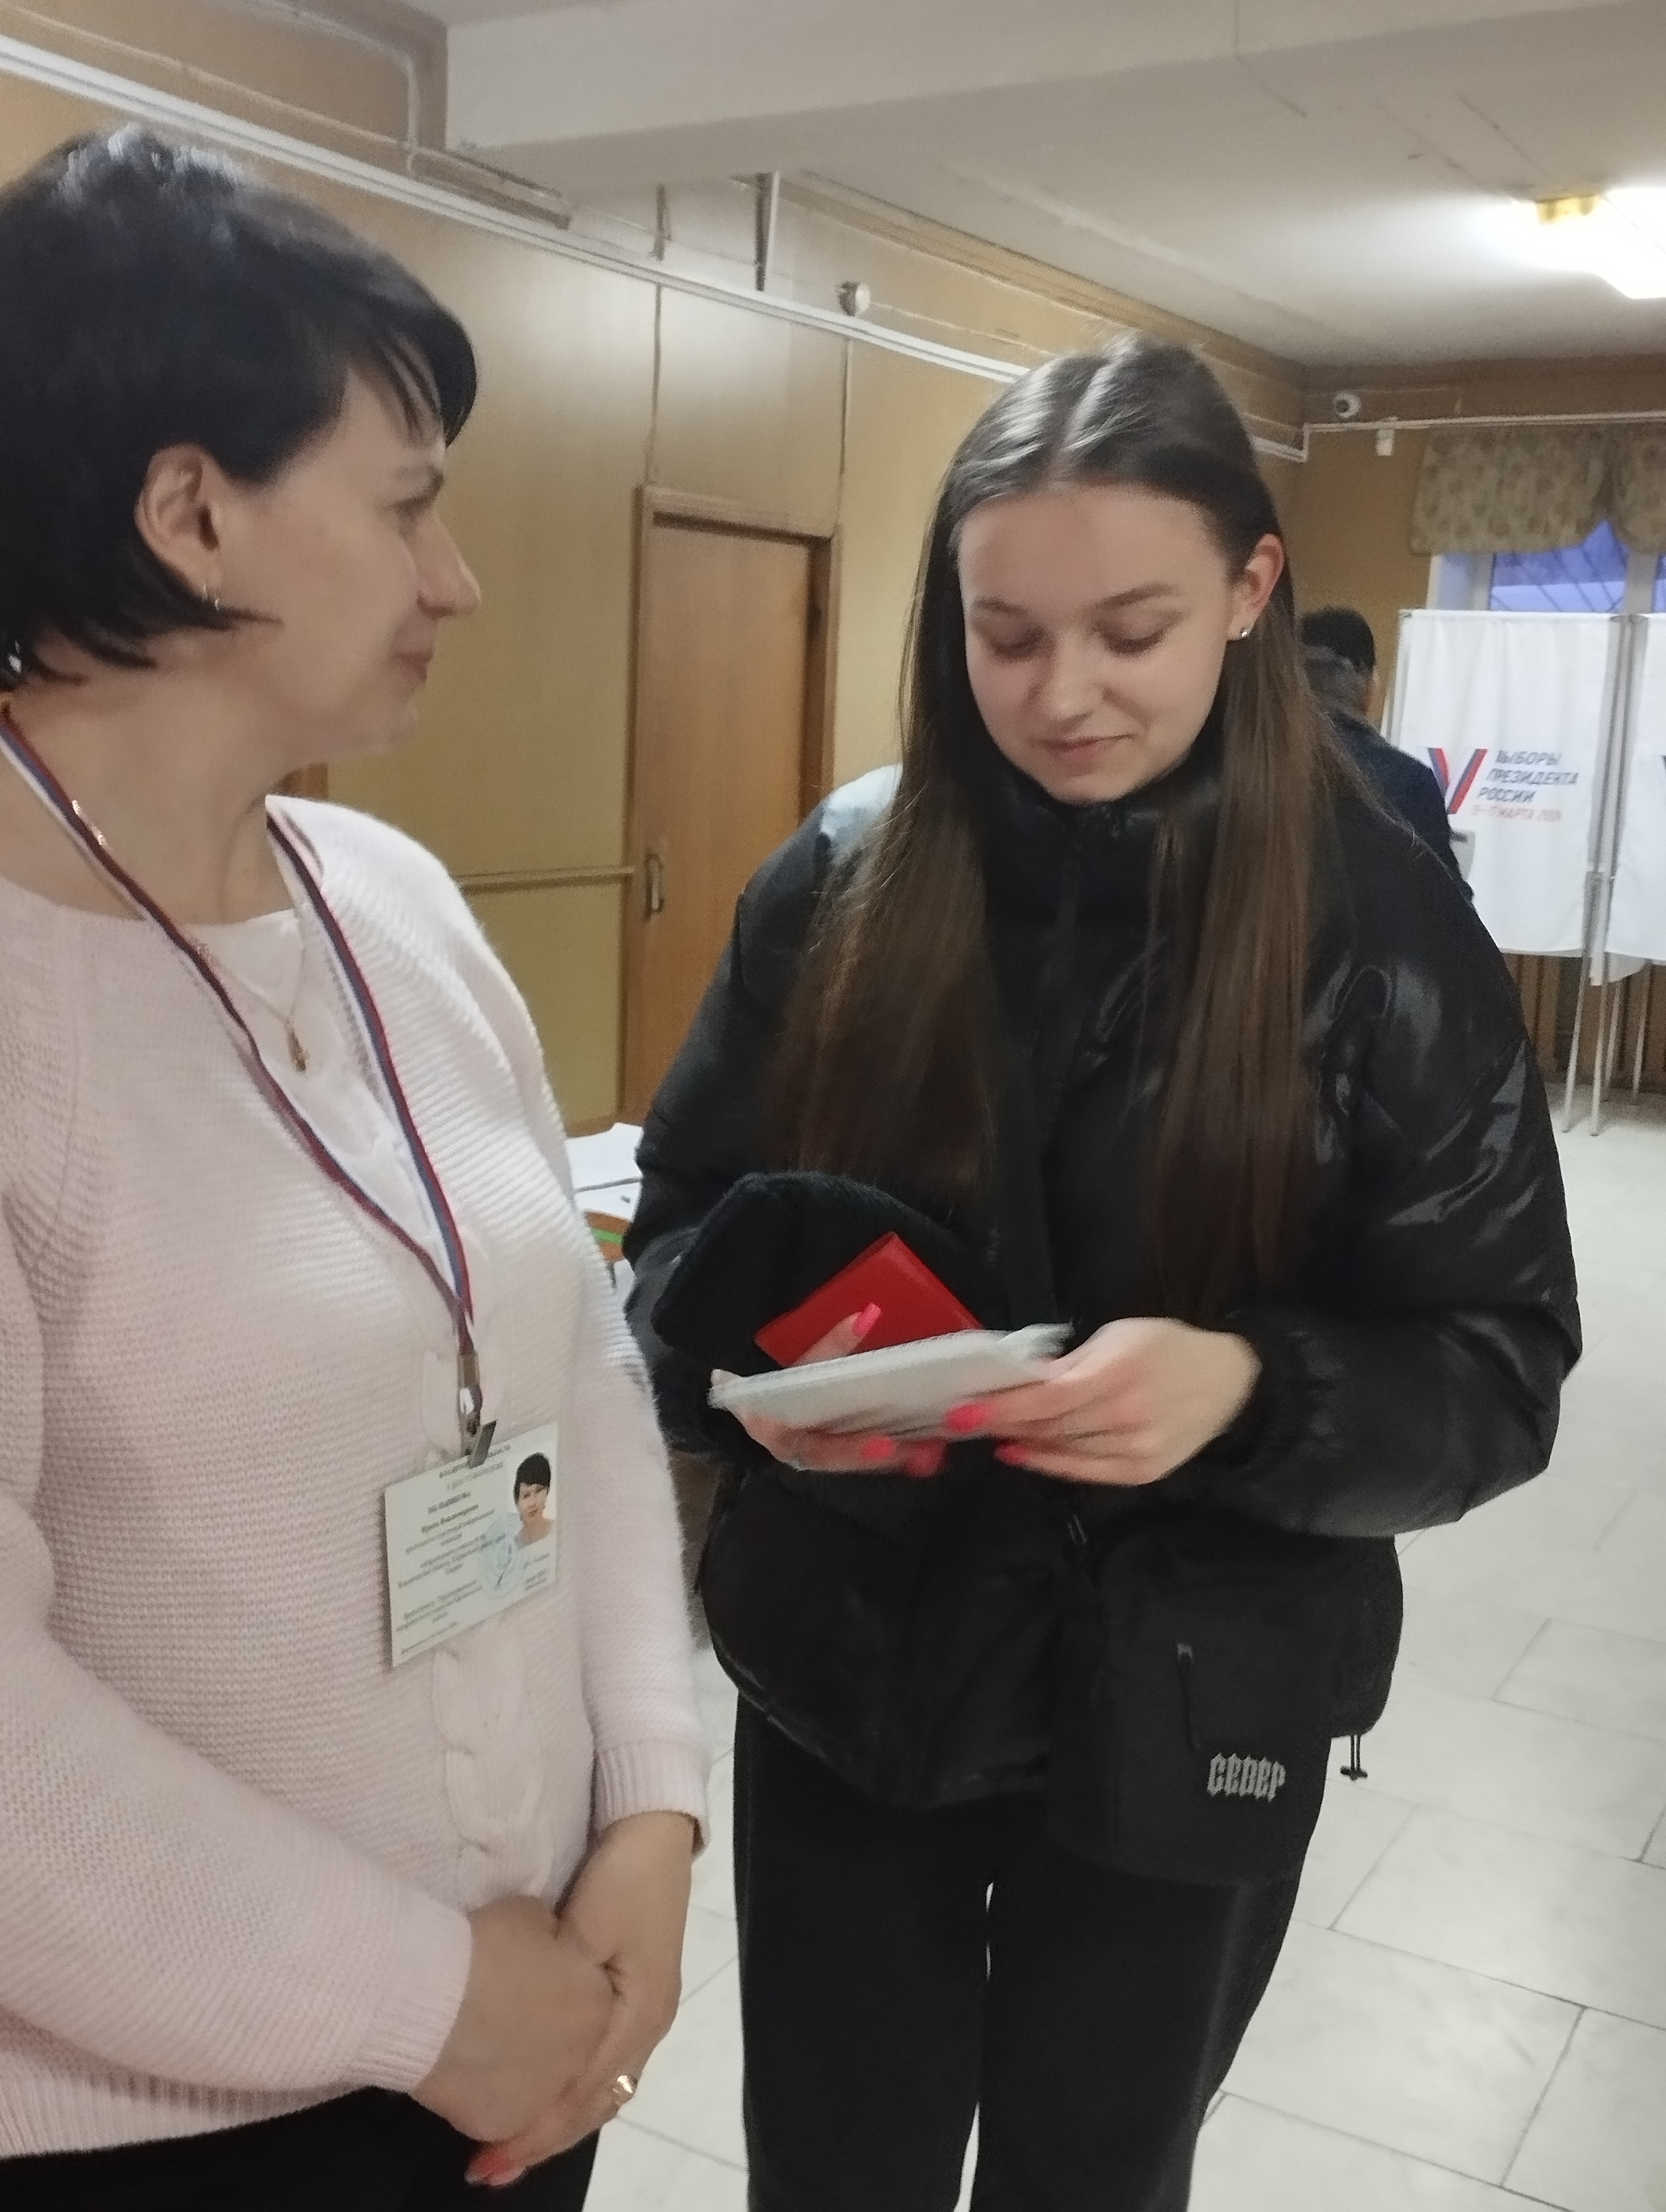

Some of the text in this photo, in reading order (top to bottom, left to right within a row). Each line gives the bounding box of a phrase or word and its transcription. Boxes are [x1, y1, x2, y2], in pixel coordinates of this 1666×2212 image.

[1495, 750, 1562, 766] ВЫБОРЫ
[1485, 768, 1579, 785] ПРЕЗИДЕНТА
[1476, 787, 1537, 803] РОССИИ
